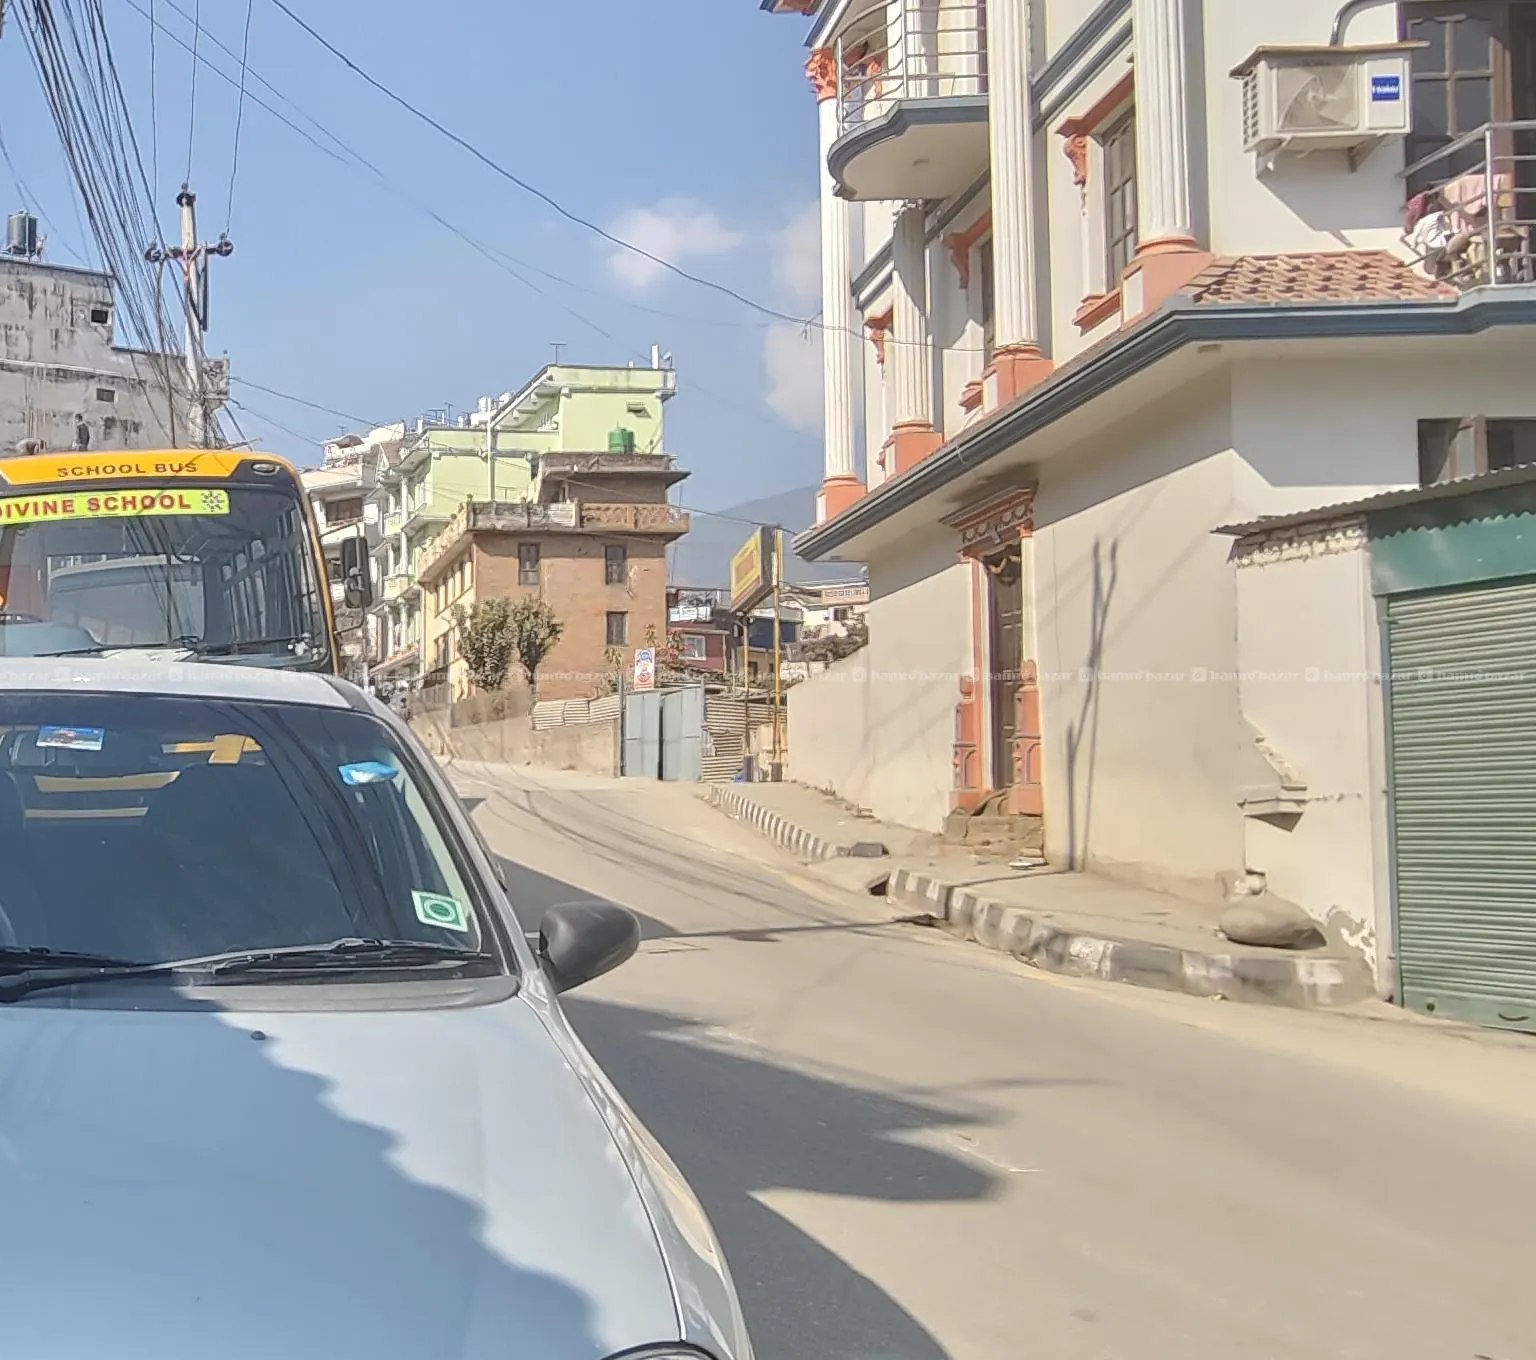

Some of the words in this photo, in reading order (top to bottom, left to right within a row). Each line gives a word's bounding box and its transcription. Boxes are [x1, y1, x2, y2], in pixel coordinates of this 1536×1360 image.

[57, 464, 146, 478] SCHOOL
[155, 462, 198, 474] BUS
[87, 494, 192, 513] SCHOOL
